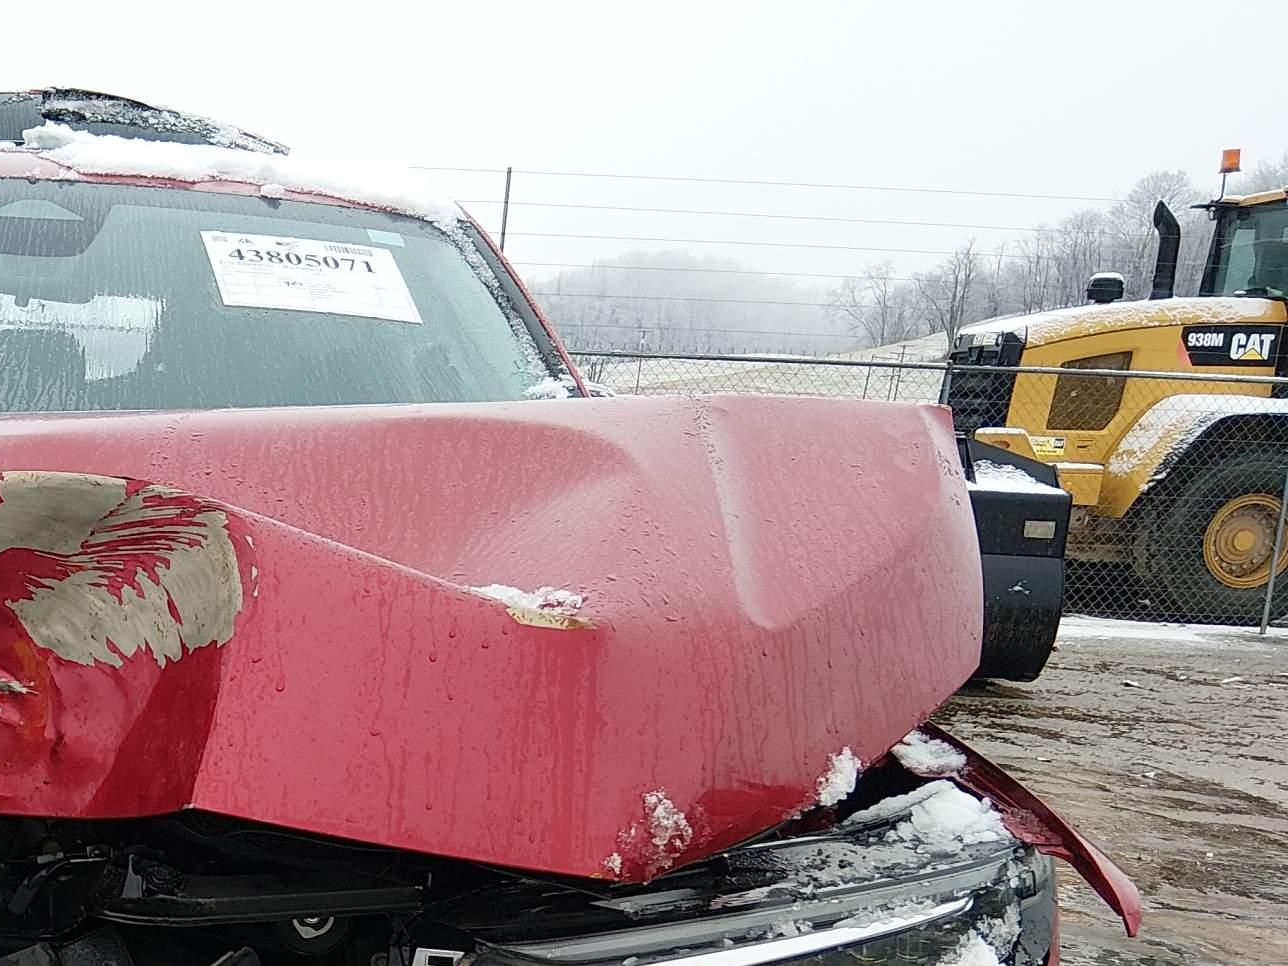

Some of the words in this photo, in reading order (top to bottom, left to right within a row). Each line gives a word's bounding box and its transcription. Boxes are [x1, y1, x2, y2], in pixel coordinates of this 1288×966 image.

[228, 248, 376, 274] 43805071
[1187, 332, 1224, 347] 938M
[1229, 333, 1275, 360] CAT
